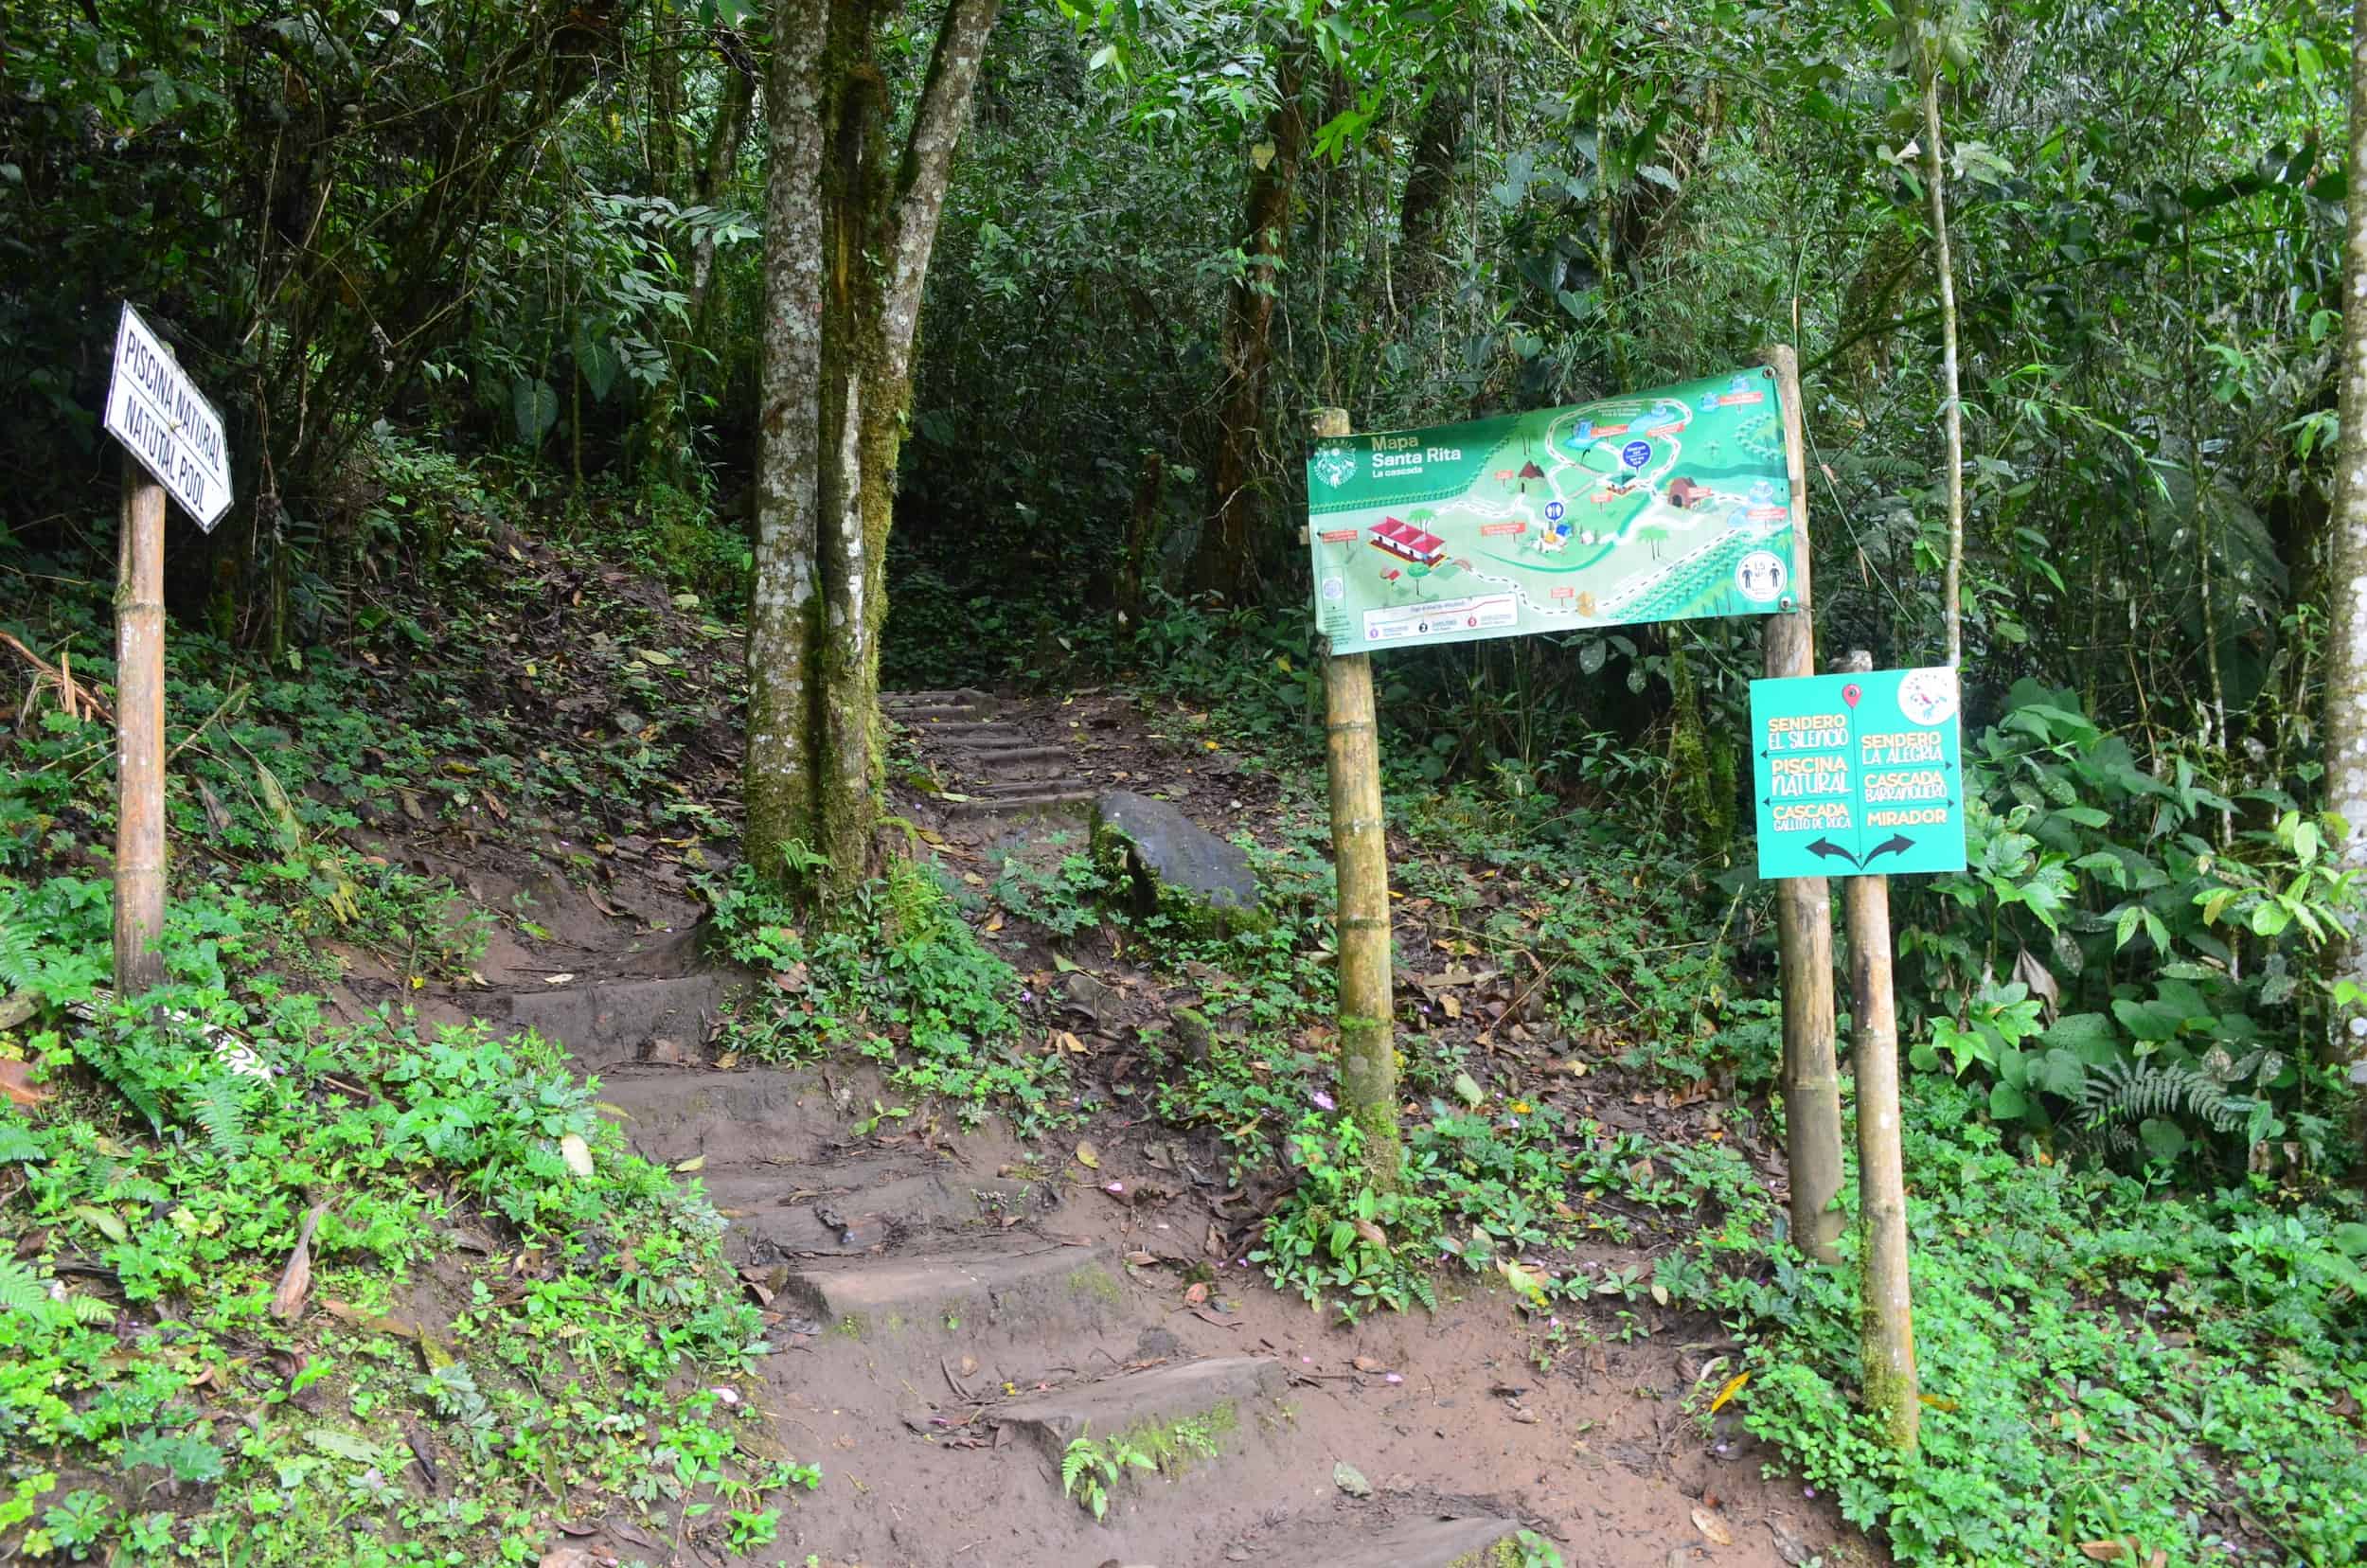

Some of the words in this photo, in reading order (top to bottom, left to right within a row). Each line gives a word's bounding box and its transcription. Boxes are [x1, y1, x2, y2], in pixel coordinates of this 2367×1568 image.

[125, 330, 173, 416] PISCINA
[176, 387, 220, 472] NATURAL
[1371, 436, 1418, 452] Mapa
[1372, 453, 1422, 468] Santa
[1427, 447, 1461, 463] Rita
[1372, 469, 1383, 478] La
[1385, 465, 1423, 476] cascada
[178, 455, 205, 512] POOL
[1768, 714, 1847, 733] SENDERO
[1769, 732, 1787, 750] EL
[1788, 727, 1849, 750] SILENCIO
[1860, 731, 1942, 749] SENDERO
[1771, 755, 1849, 775] PISCINA
[1861, 748, 1881, 765] LA
[1771, 772, 1853, 797] NATURAL
[1864, 770, 1945, 789] CASCADA
[1864, 783, 1948, 803] BARRANQUERO
[1772, 803, 1849, 820] CASCADA
[1866, 809, 1948, 827] MIRADOR
[1773, 817, 1810, 832] GALLITO
[1812, 816, 1825, 830] DE
[1825, 816, 1852, 829] ROCA
